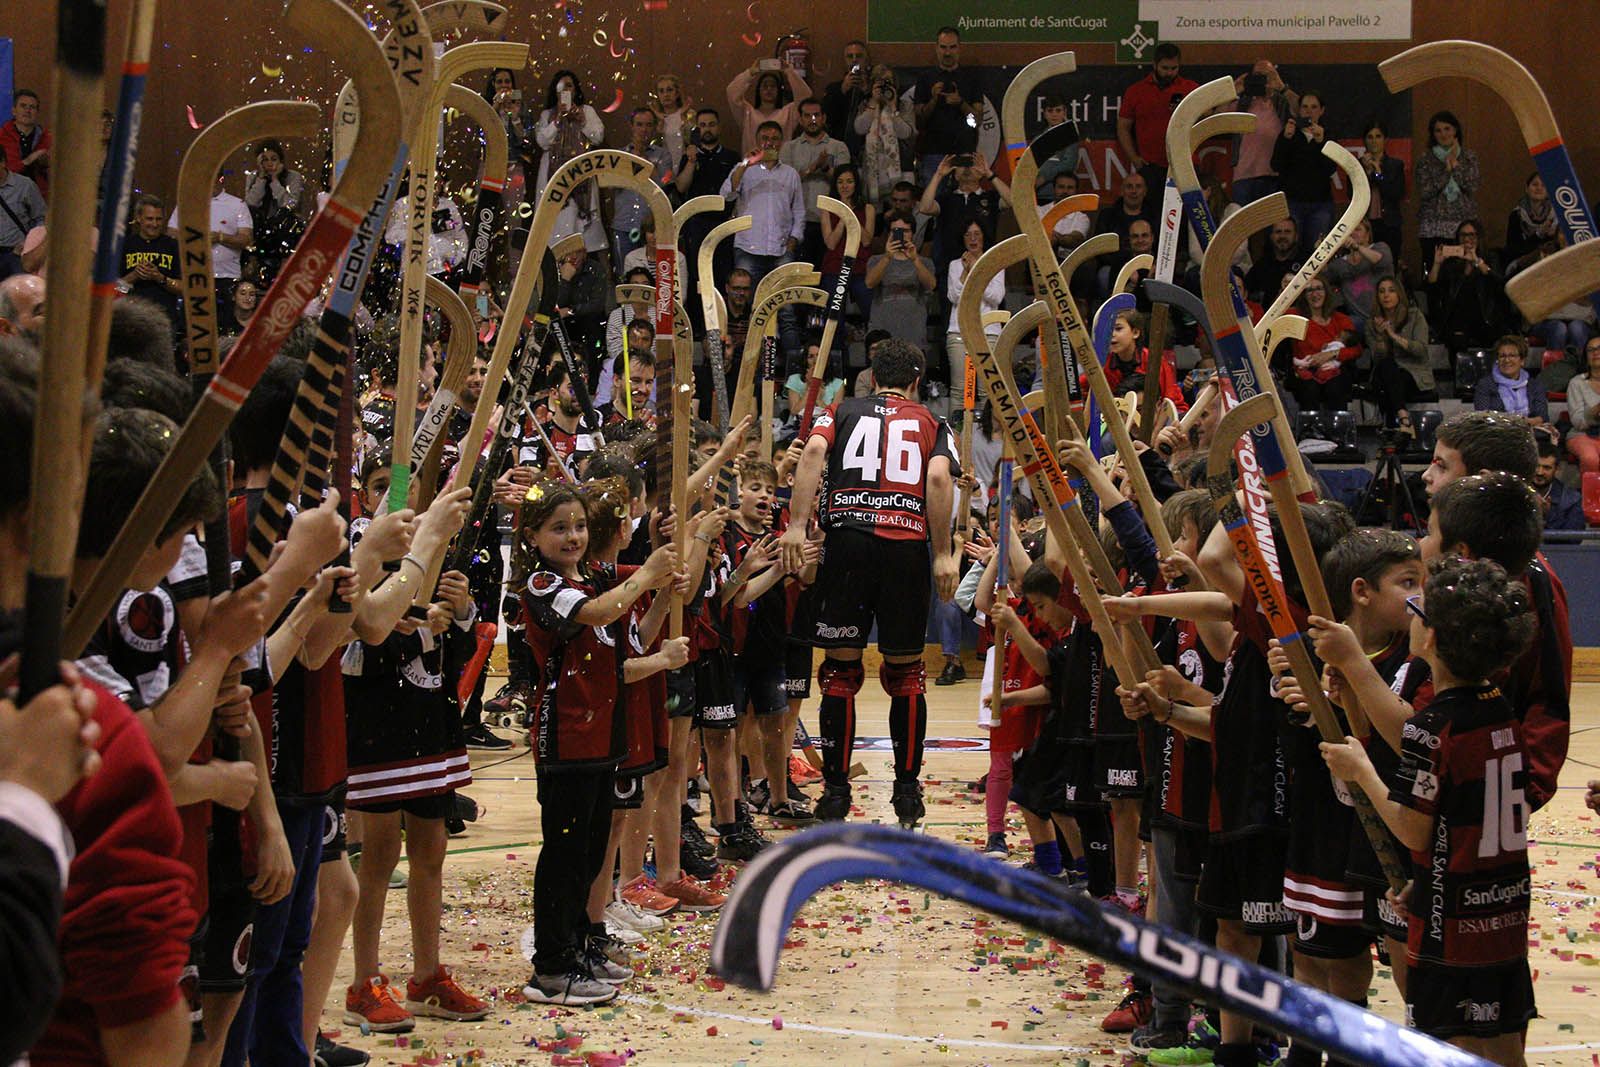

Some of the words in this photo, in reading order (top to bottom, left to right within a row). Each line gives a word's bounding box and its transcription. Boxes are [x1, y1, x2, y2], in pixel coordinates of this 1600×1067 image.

[957, 15, 1026, 30] Ajuntament
[1030, 16, 1045, 28] de
[1047, 16, 1108, 30] SantCugat
[1176, 16, 1206, 28] Zona
[1208, 16, 1264, 31] esportiva
[1266, 16, 1325, 31] municipal
[1328, 14, 1370, 27] Pavelló
[1373, 16, 1381, 27] 2
[550, 155, 621, 205] AZEMAD
[411, 168, 429, 266] TORVIK
[1302, 222, 1349, 281] AZEMAD
[183, 225, 212, 366] AZEMAD
[407, 287, 421, 317] XK4
[656, 258, 672, 322] Reno
[753, 289, 805, 327] AZEMAD
[831, 263, 852, 312] BAROVARI
[1045, 270, 1081, 332] federal
[1057, 324, 1080, 394] INTERNACIONAL
[430, 402, 449, 427] One
[842, 415, 923, 486] 46
[834, 491, 921, 512] SantCugatCreix
[1237, 448, 1283, 583] MINICRO
[1234, 537, 1286, 623] OLYMPIC
[815, 621, 860, 639] Reno
[540, 690, 551, 722] SANT
[539, 724, 549, 758] HOTEL
[1163, 735, 1175, 767] SANT
[1273, 772, 1286, 817] CUGAT
[1478, 753, 1527, 857] 16
[1437, 814, 1449, 855] HOTEL
[1432, 855, 1447, 889] SANT
[1463, 878, 1530, 907] SantCugatC
[1429, 891, 1444, 942] CUGAT
